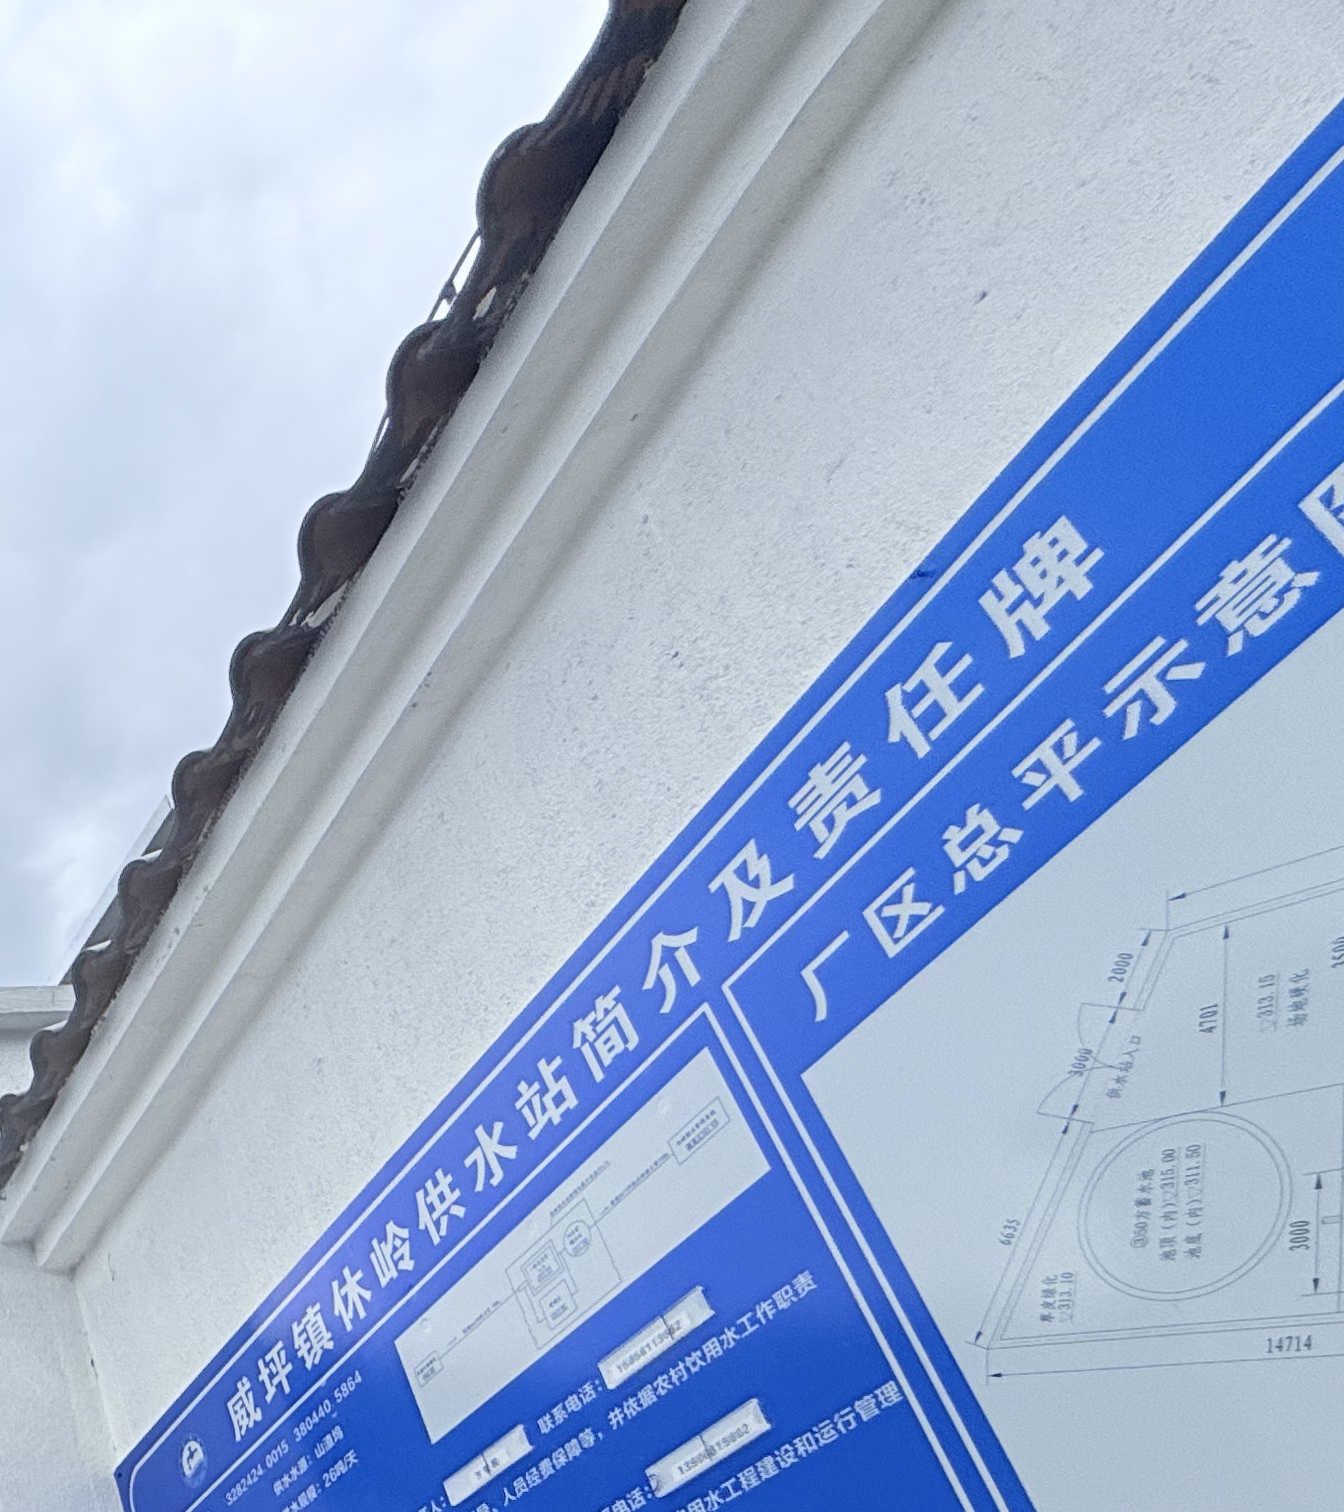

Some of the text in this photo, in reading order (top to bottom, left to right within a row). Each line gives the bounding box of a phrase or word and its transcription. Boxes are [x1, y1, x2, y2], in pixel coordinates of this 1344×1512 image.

[226, 515, 1104, 1442] 威坪镇休岭供水站简介及责任牌
[1108, 952, 1133, 983] 2000
[1198, 1004, 1218, 1033] 4701
[1068, 1048, 1093, 1077] 3000
[998, 1219, 1020, 1246] 6635
[1288, 1220, 1310, 1251] 3000
[1266, 1334, 1312, 1353] 14714
